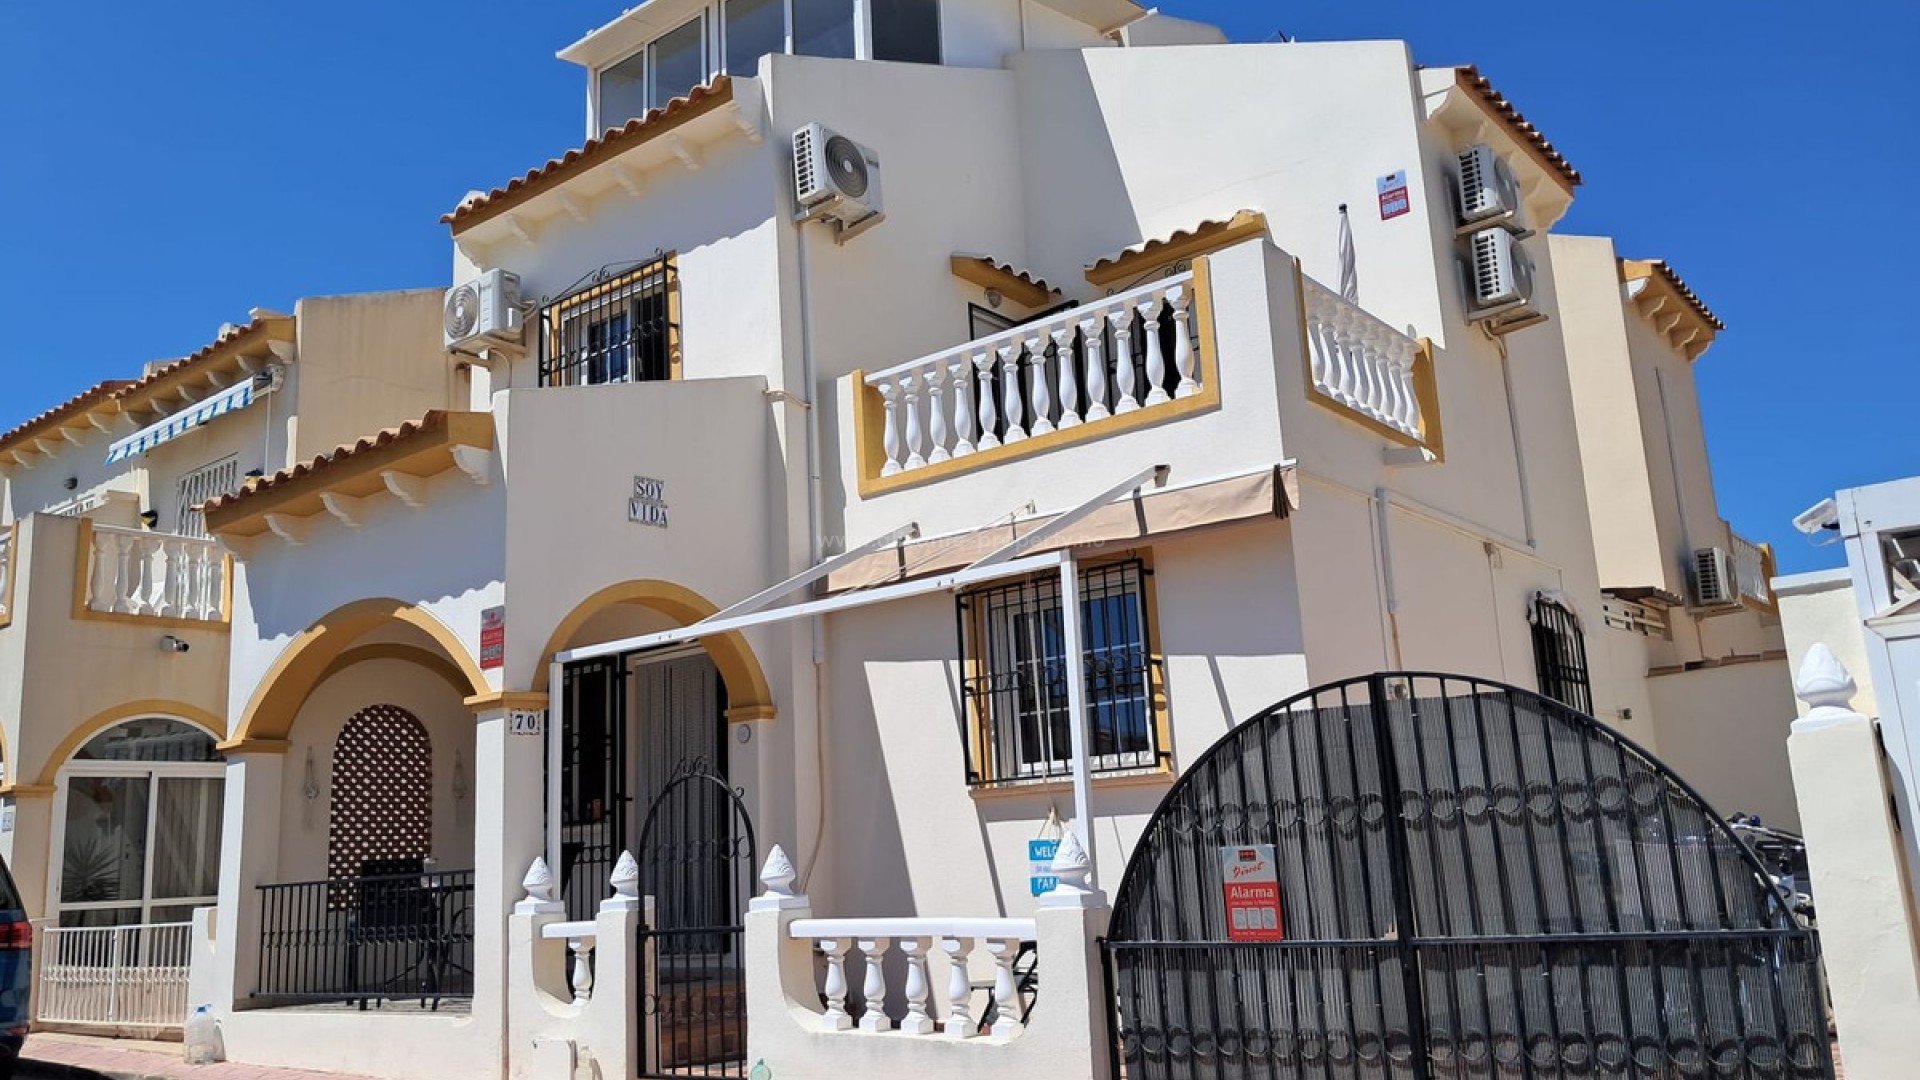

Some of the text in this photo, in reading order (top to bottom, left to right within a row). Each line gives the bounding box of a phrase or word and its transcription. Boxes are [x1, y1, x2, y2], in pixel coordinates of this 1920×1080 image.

[637, 482, 662, 499] SOY
[631, 502, 667, 524] VIDA
[515, 714, 535, 730] 70
[1231, 885, 1274, 898] Alarma
